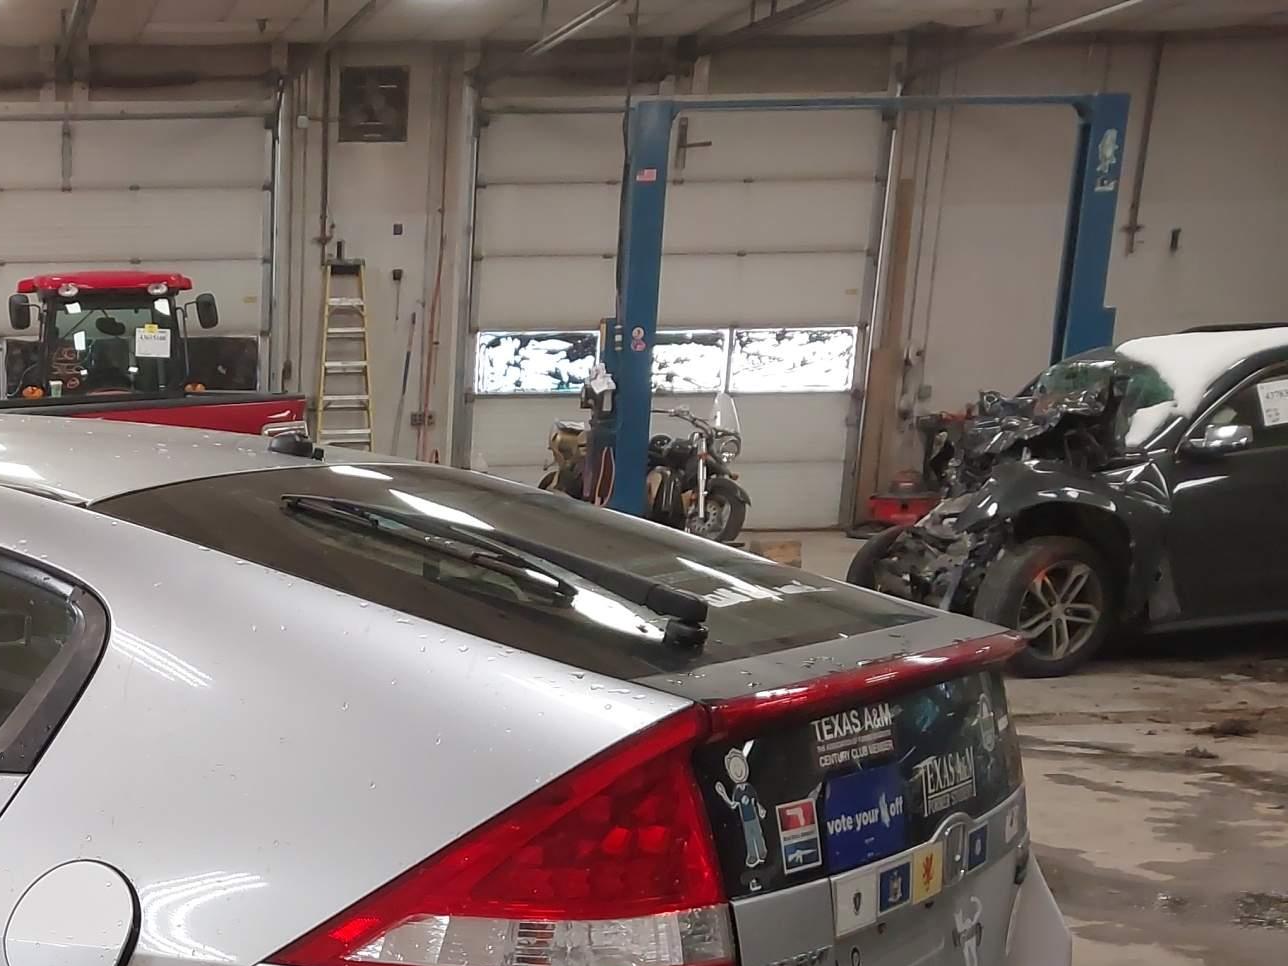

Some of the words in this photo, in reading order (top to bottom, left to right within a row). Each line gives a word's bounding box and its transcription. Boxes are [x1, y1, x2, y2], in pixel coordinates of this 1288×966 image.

[810, 709, 862, 742] TEXAS
[863, 703, 893, 731] A&M
[851, 745, 869, 760] CLUB
[910, 756, 955, 817] TEXAS
[827, 815, 853, 835] vote
[855, 808, 880, 832] your
[889, 796, 904, 816] off
